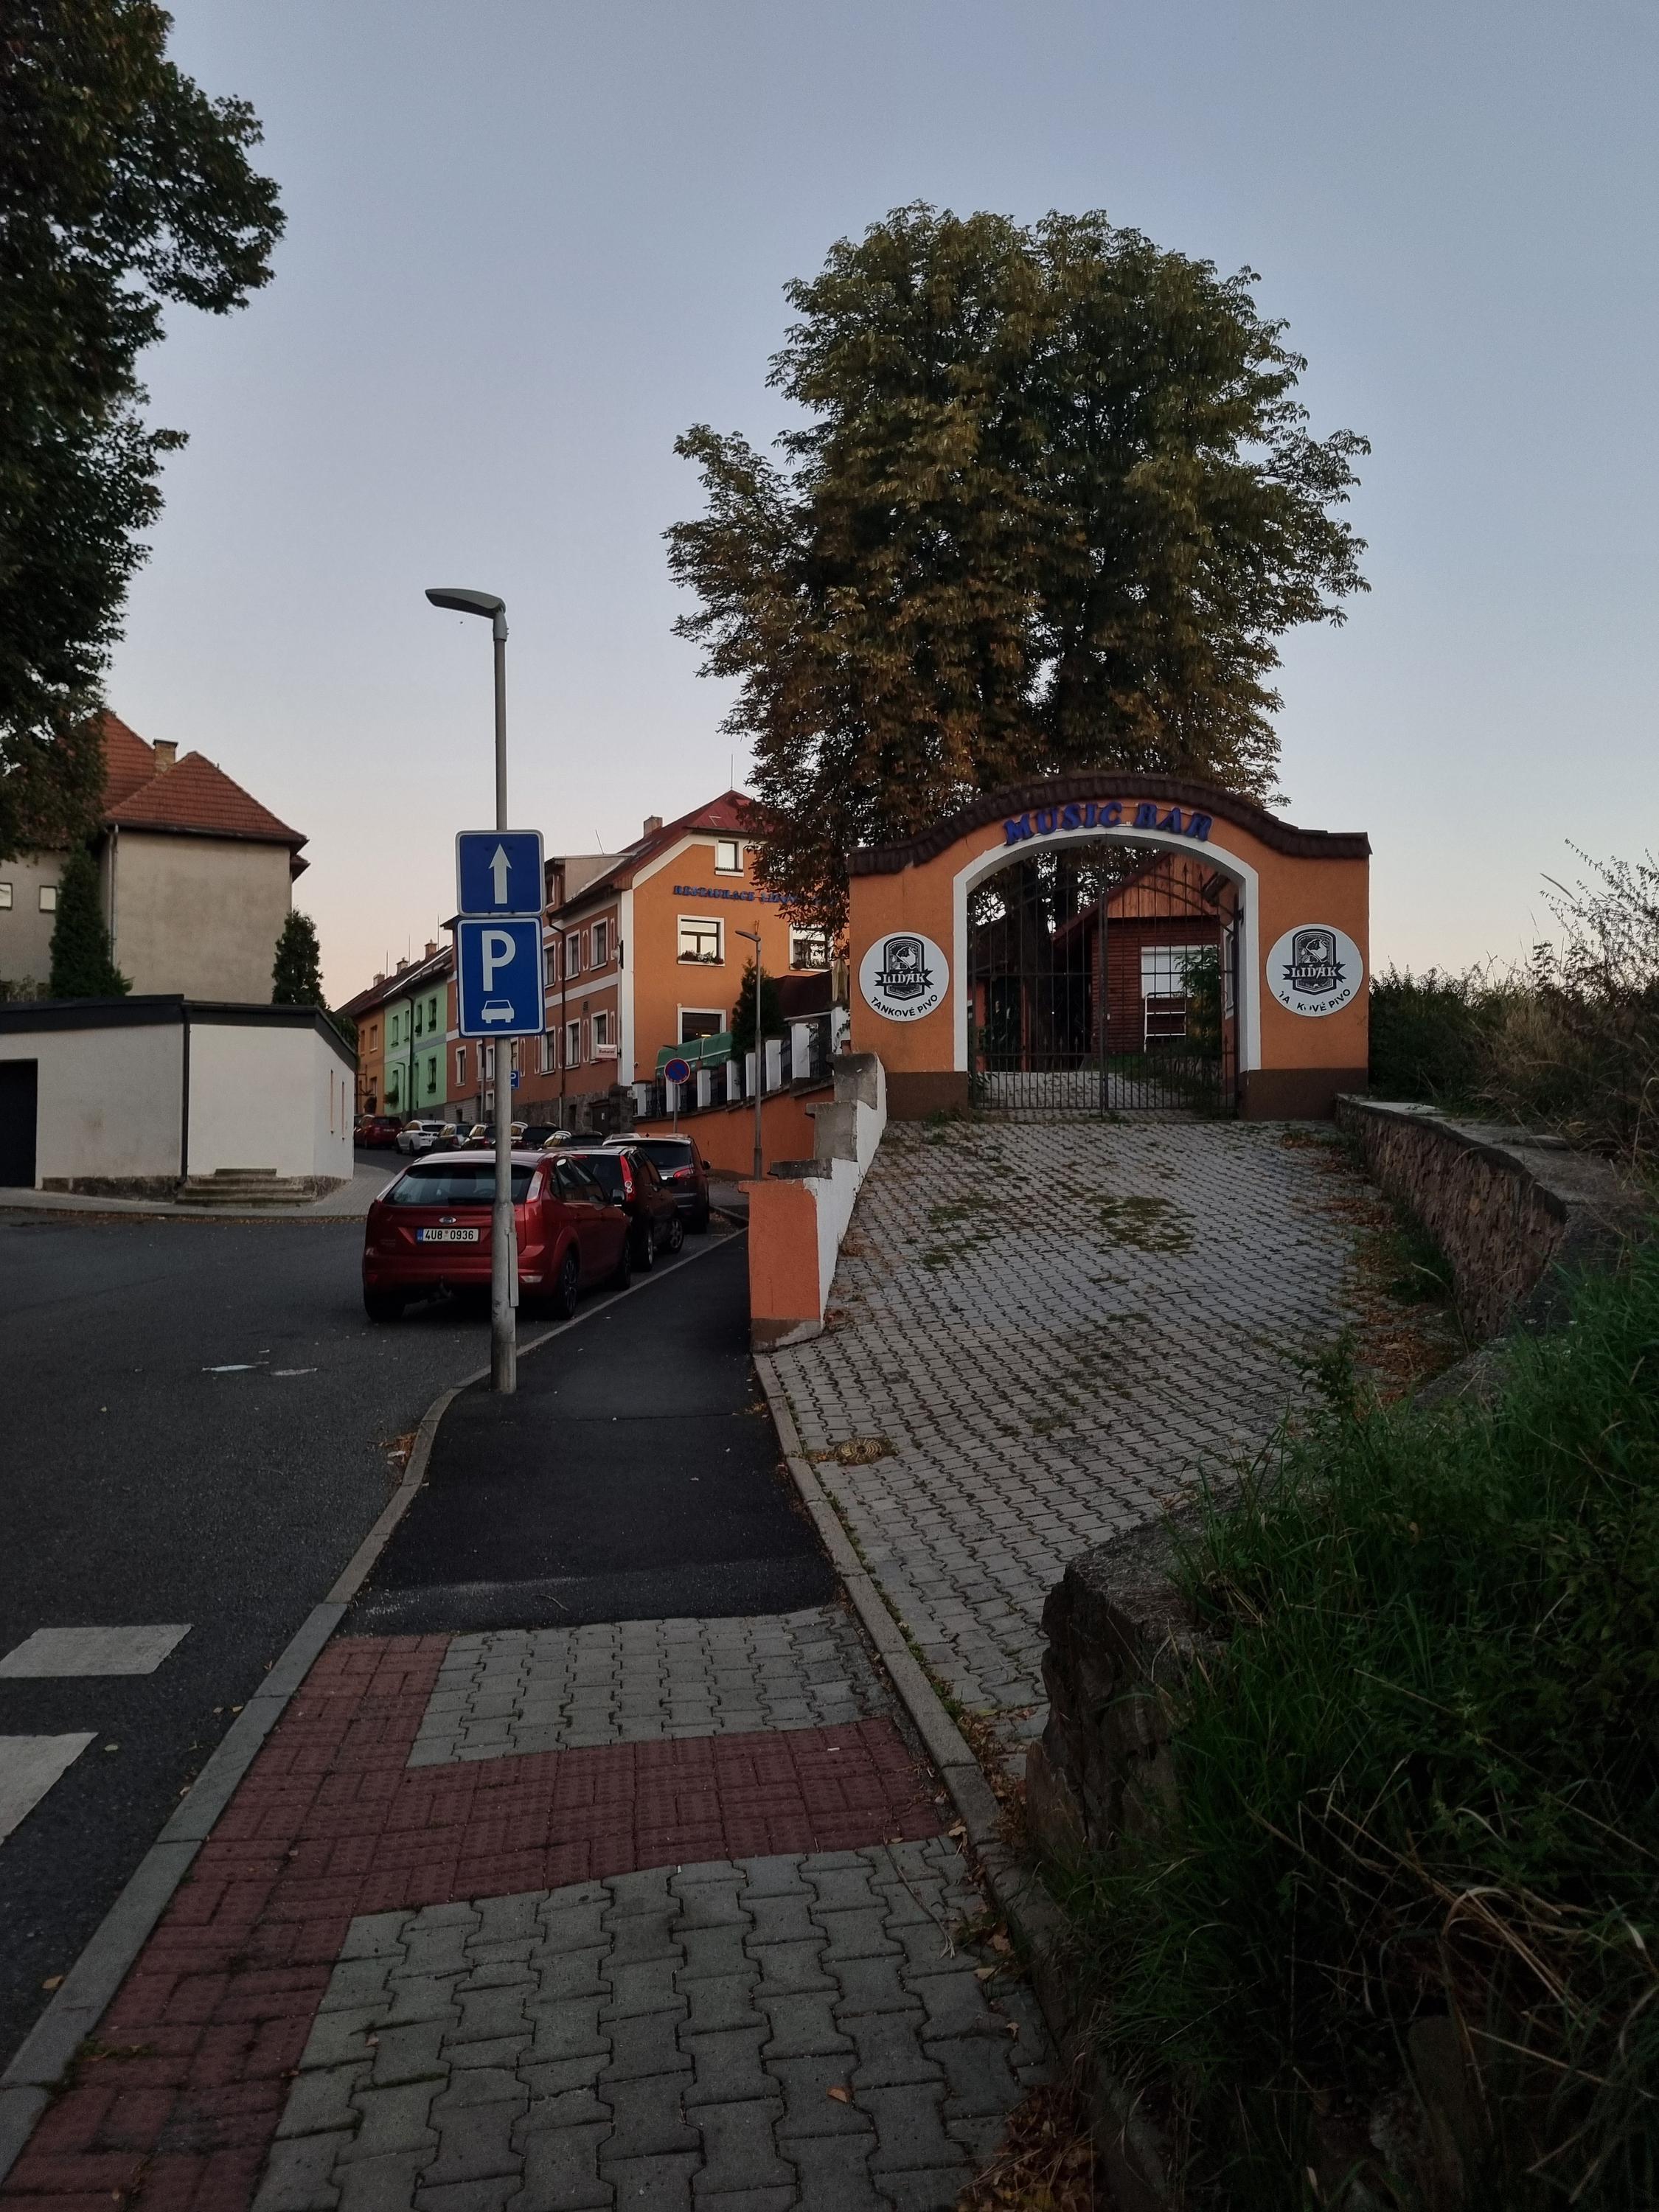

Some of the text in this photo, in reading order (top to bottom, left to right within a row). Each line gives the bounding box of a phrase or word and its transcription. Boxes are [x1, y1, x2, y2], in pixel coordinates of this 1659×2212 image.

[1003, 801, 1213, 846] MUSIC BAR
[481, 931, 516, 992] P
[871, 995, 938, 1017] TANKOVÉ PIVO
[1328, 989, 1351, 1009] PIVO
[425, 1230, 442, 1240] 4U8
[450, 1230, 474, 1240] 0936
